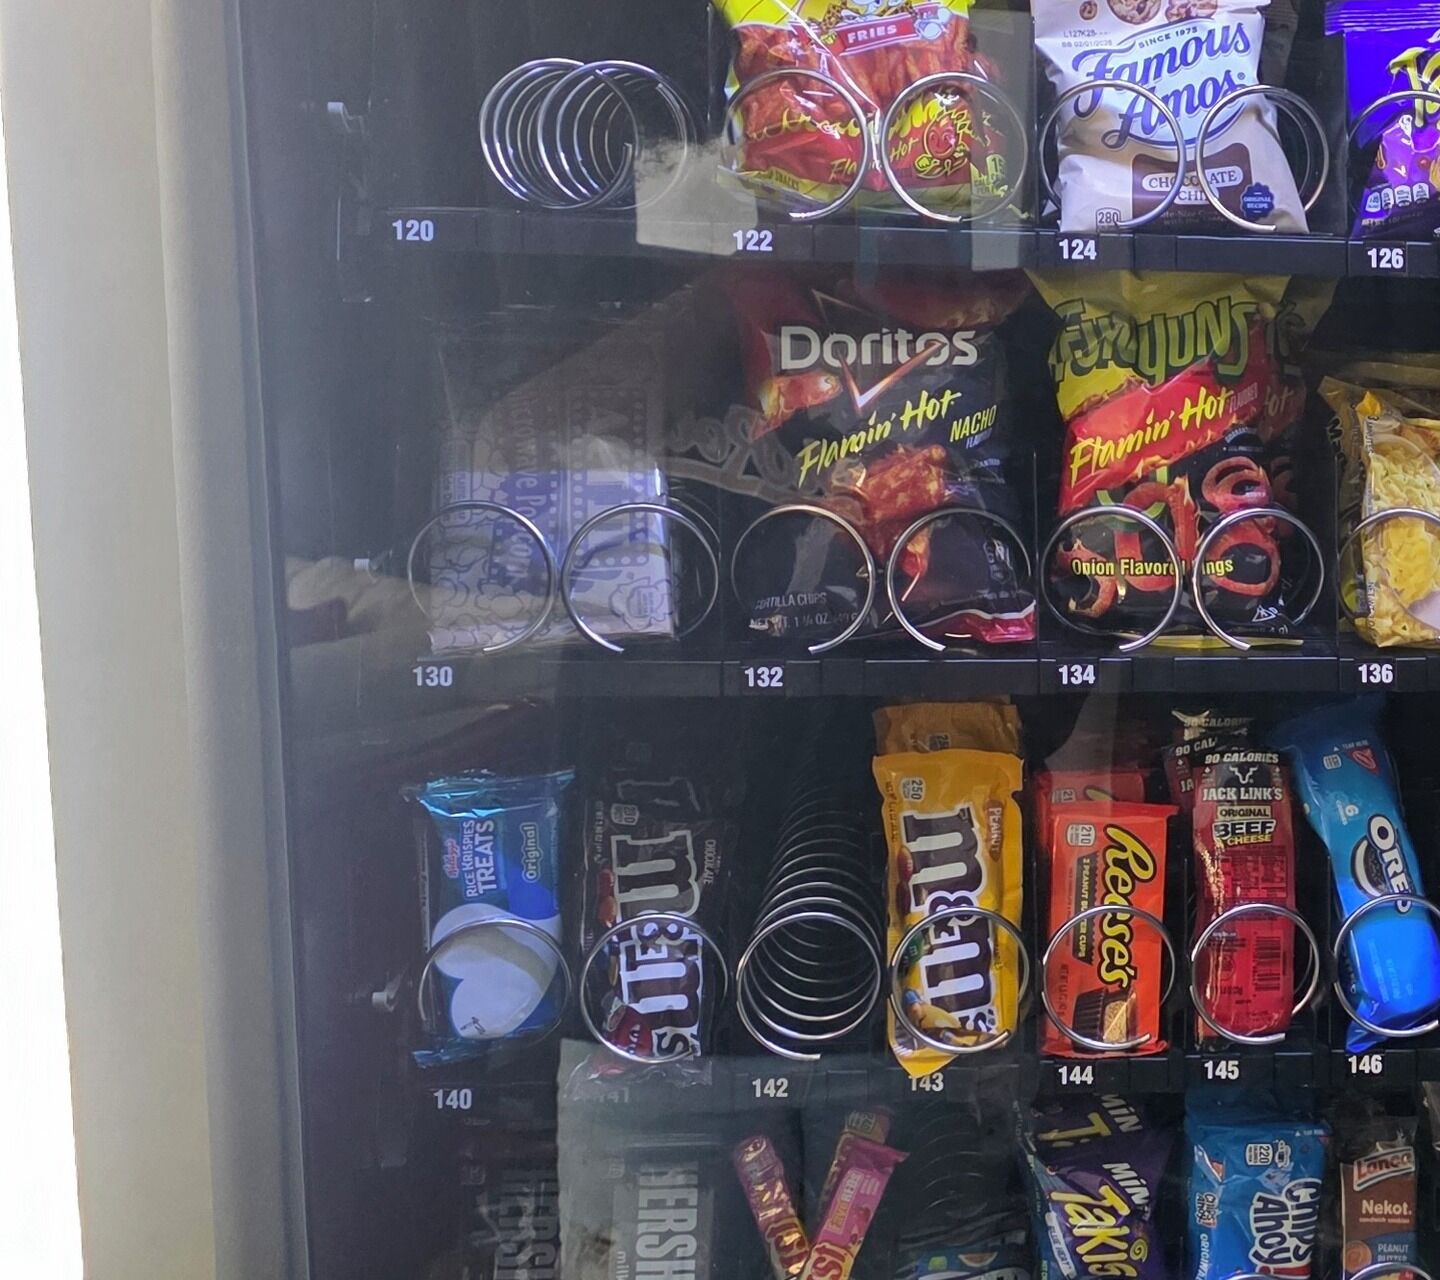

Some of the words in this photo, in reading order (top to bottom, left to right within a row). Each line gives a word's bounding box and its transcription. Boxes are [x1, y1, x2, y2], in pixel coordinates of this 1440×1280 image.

[847, 23, 898, 44] FRIES
[1139, 31, 1173, 49] SINCE
[1070, 20, 1252, 119] Famous
[1101, 68, 1241, 150] Amos
[392, 219, 434, 242] 120
[732, 229, 774, 252] 122
[1059, 238, 1098, 260] 124
[1367, 246, 1404, 269] 126
[780, 324, 979, 371] Doritos
[948, 403, 997, 442] NACHO
[799, 410, 893, 488] Flamin'
[900, 389, 962, 431] Hot
[1069, 410, 1175, 488] Flamin'
[1180, 387, 1233, 432] Hot
[1072, 558, 1115, 577] Onion
[412, 665, 453, 687] 130
[744, 666, 784, 688] 132
[1058, 663, 1096, 686] 134
[1358, 662, 1394, 684] 136
[1175, 744, 1191, 757] 90
[1204, 754, 1220, 764] 90
[1222, 751, 1279, 763] CALORIES
[909, 778, 924, 800] 250
[1202, 787, 1237, 801] JACK
[1239, 786, 1283, 800] LINK'S
[1219, 807, 1270, 818] ORIGINAL
[988, 806, 1004, 853] PEANUT
[1080, 824, 1093, 846] 210
[1213, 820, 1275, 838] BEEF
[1226, 834, 1272, 846] CHEESE
[461, 820, 476, 872] KRISPIES
[523, 823, 540, 880] Original
[475, 819, 497, 896] TREATS
[1366, 814, 1414, 915] OREO
[465, 872, 477, 898] RICE
[1098, 823, 1158, 990] Reese's
[1203, 1059, 1240, 1080] 145
[1347, 1053, 1384, 1075] 146
[909, 1072, 945, 1093] 143
[1058, 1065, 1095, 1086] 144
[433, 1087, 473, 1111] 140
[751, 1077, 789, 1099] 142
[1258, 1144, 1271, 1164] 220
[1377, 1242, 1410, 1254] PEANUT
